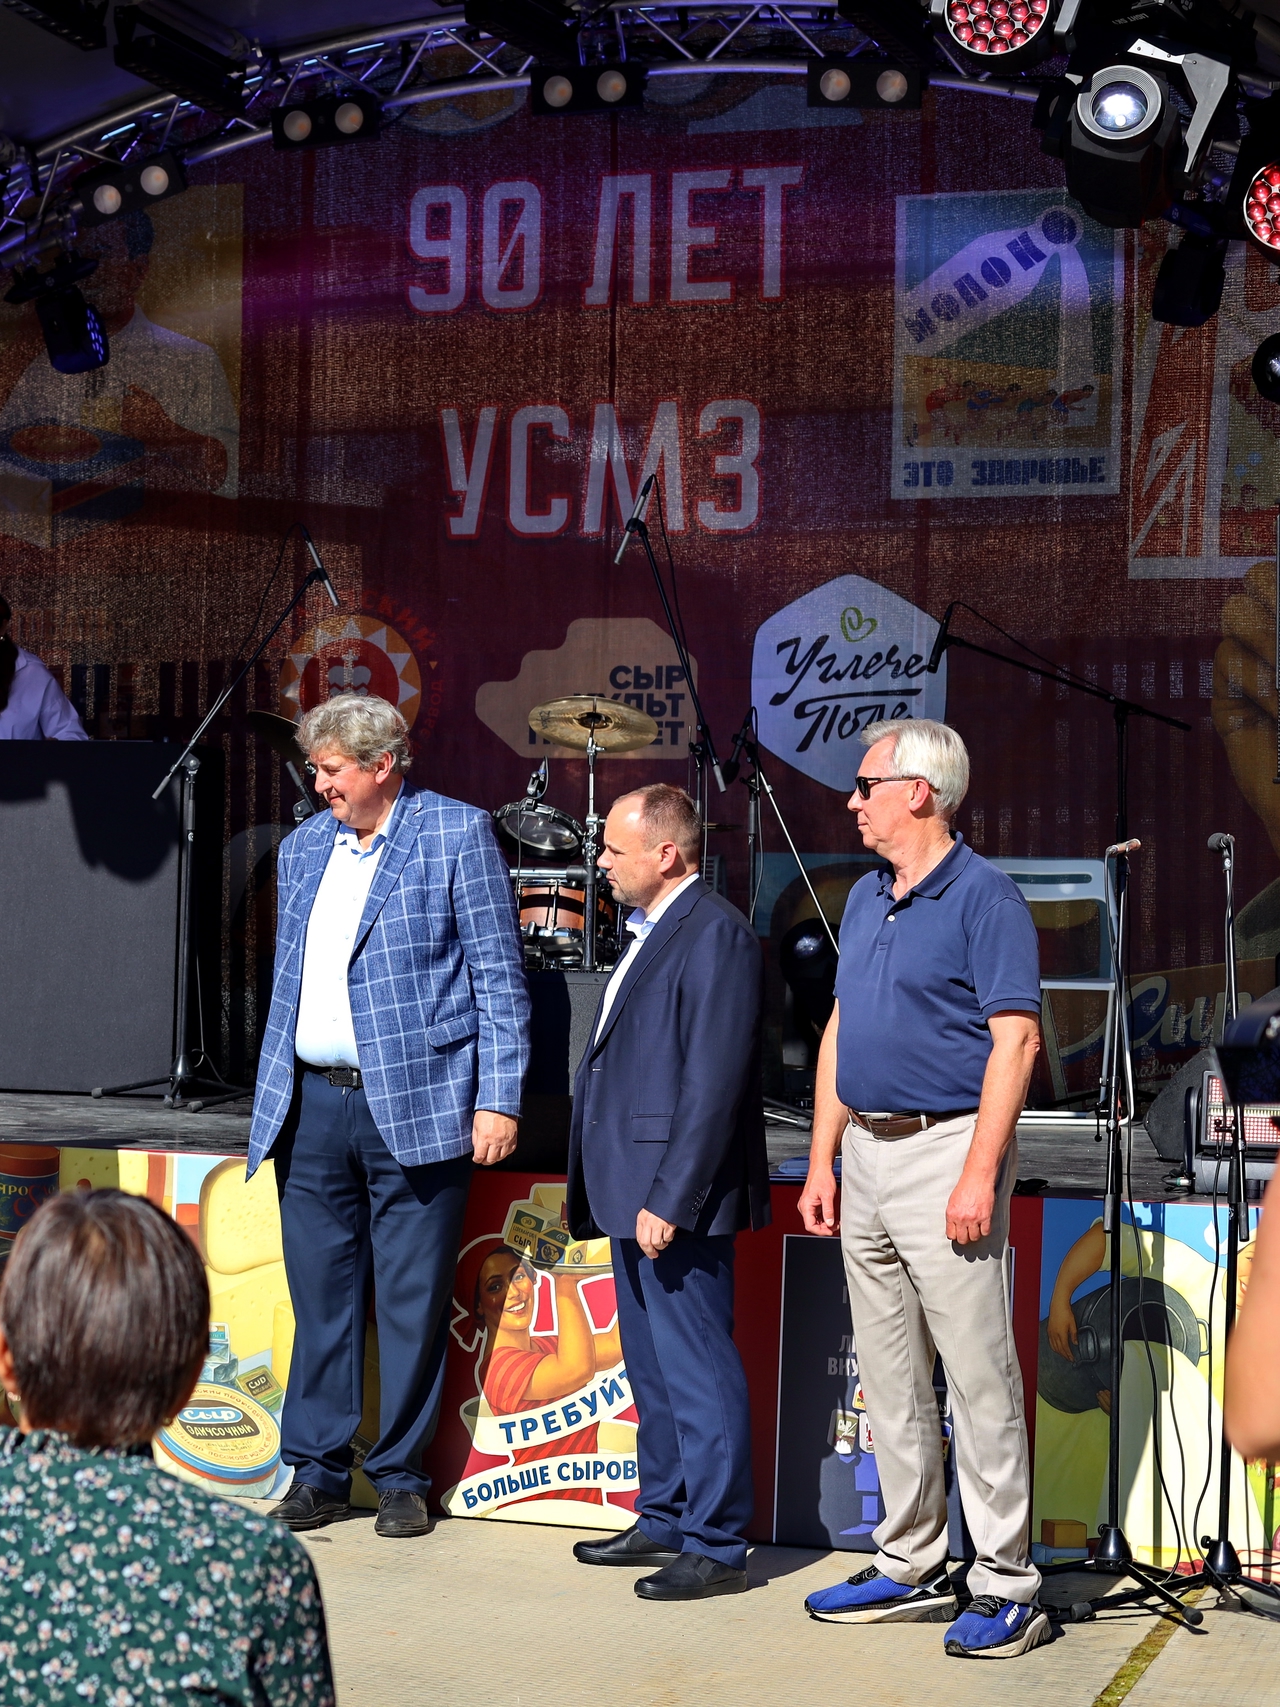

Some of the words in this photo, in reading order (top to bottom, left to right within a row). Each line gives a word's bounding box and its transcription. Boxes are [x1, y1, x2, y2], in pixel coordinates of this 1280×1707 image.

[407, 179, 543, 313] 90
[584, 165, 805, 306] ЛЕТ
[439, 398, 763, 538] УСМЗ
[903, 459, 955, 488] ЭТО
[971, 456, 1107, 488] ЗДОРОВЬЕ
[609, 665, 686, 690] СЫР
[462, 1465, 552, 1509] БОЛЬШЕ
[557, 1460, 638, 1481] СЫРОВ
[1004, 1603, 1020, 1628] MBT
